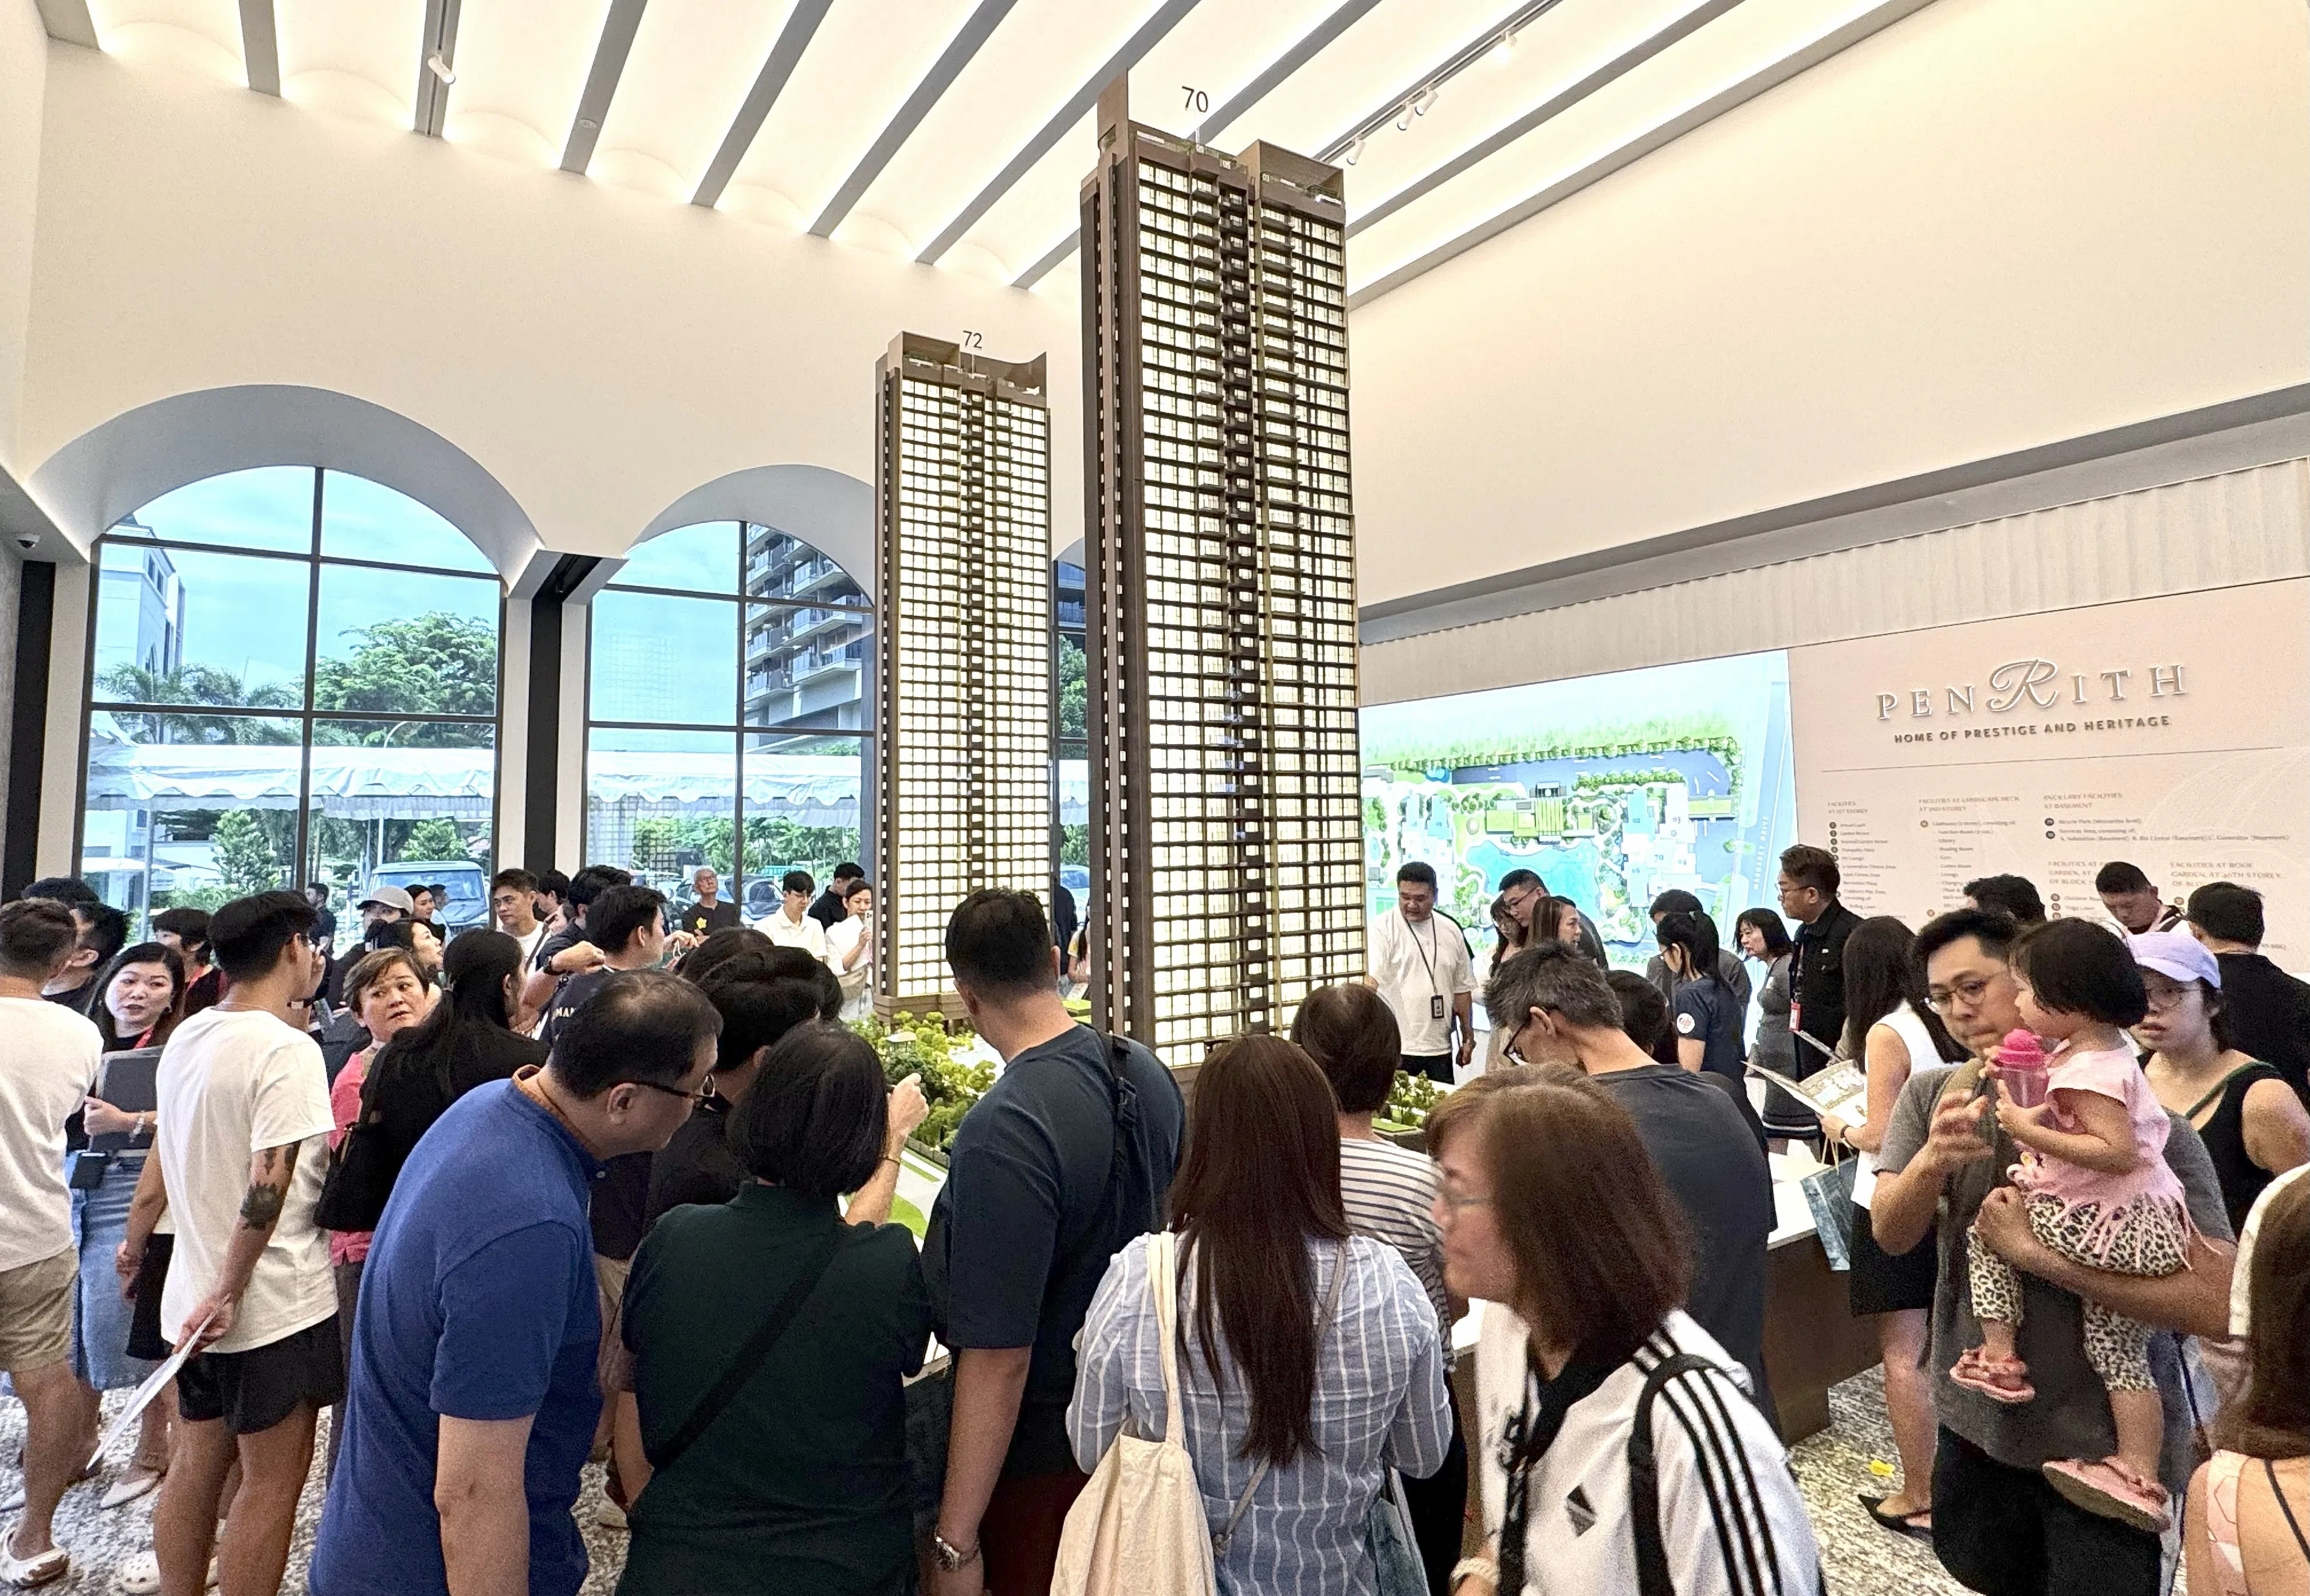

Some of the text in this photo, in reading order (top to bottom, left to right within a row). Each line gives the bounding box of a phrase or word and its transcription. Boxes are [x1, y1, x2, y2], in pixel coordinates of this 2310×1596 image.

[1182, 85, 1208, 113] 70
[962, 330, 983, 350] 72
[1876, 658, 2187, 720] PENRITH
[1895, 716, 2169, 743] HOME OF PRESTIGE AND HERITAGE
